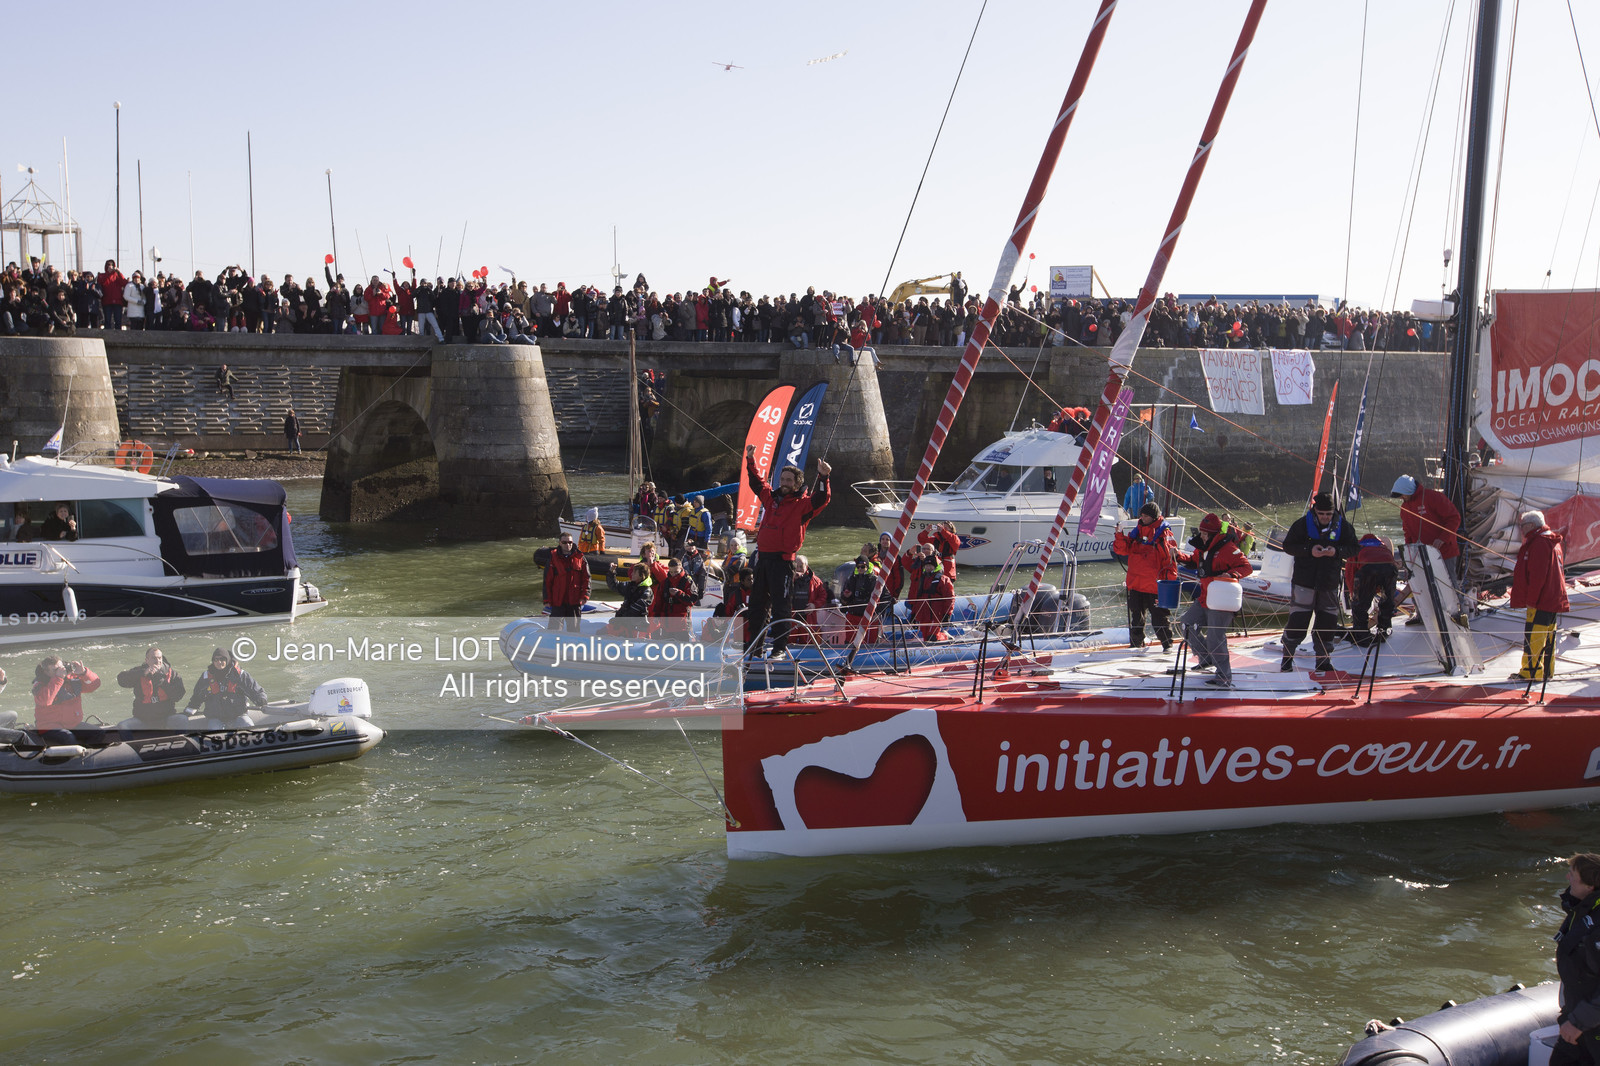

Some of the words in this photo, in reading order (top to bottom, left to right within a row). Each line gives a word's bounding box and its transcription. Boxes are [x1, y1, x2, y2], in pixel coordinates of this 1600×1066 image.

[757, 405, 782, 425] 49
[1502, 431, 1541, 446] WORLD
[0, 553, 37, 566] LUE
[27, 608, 87, 625] D3676
